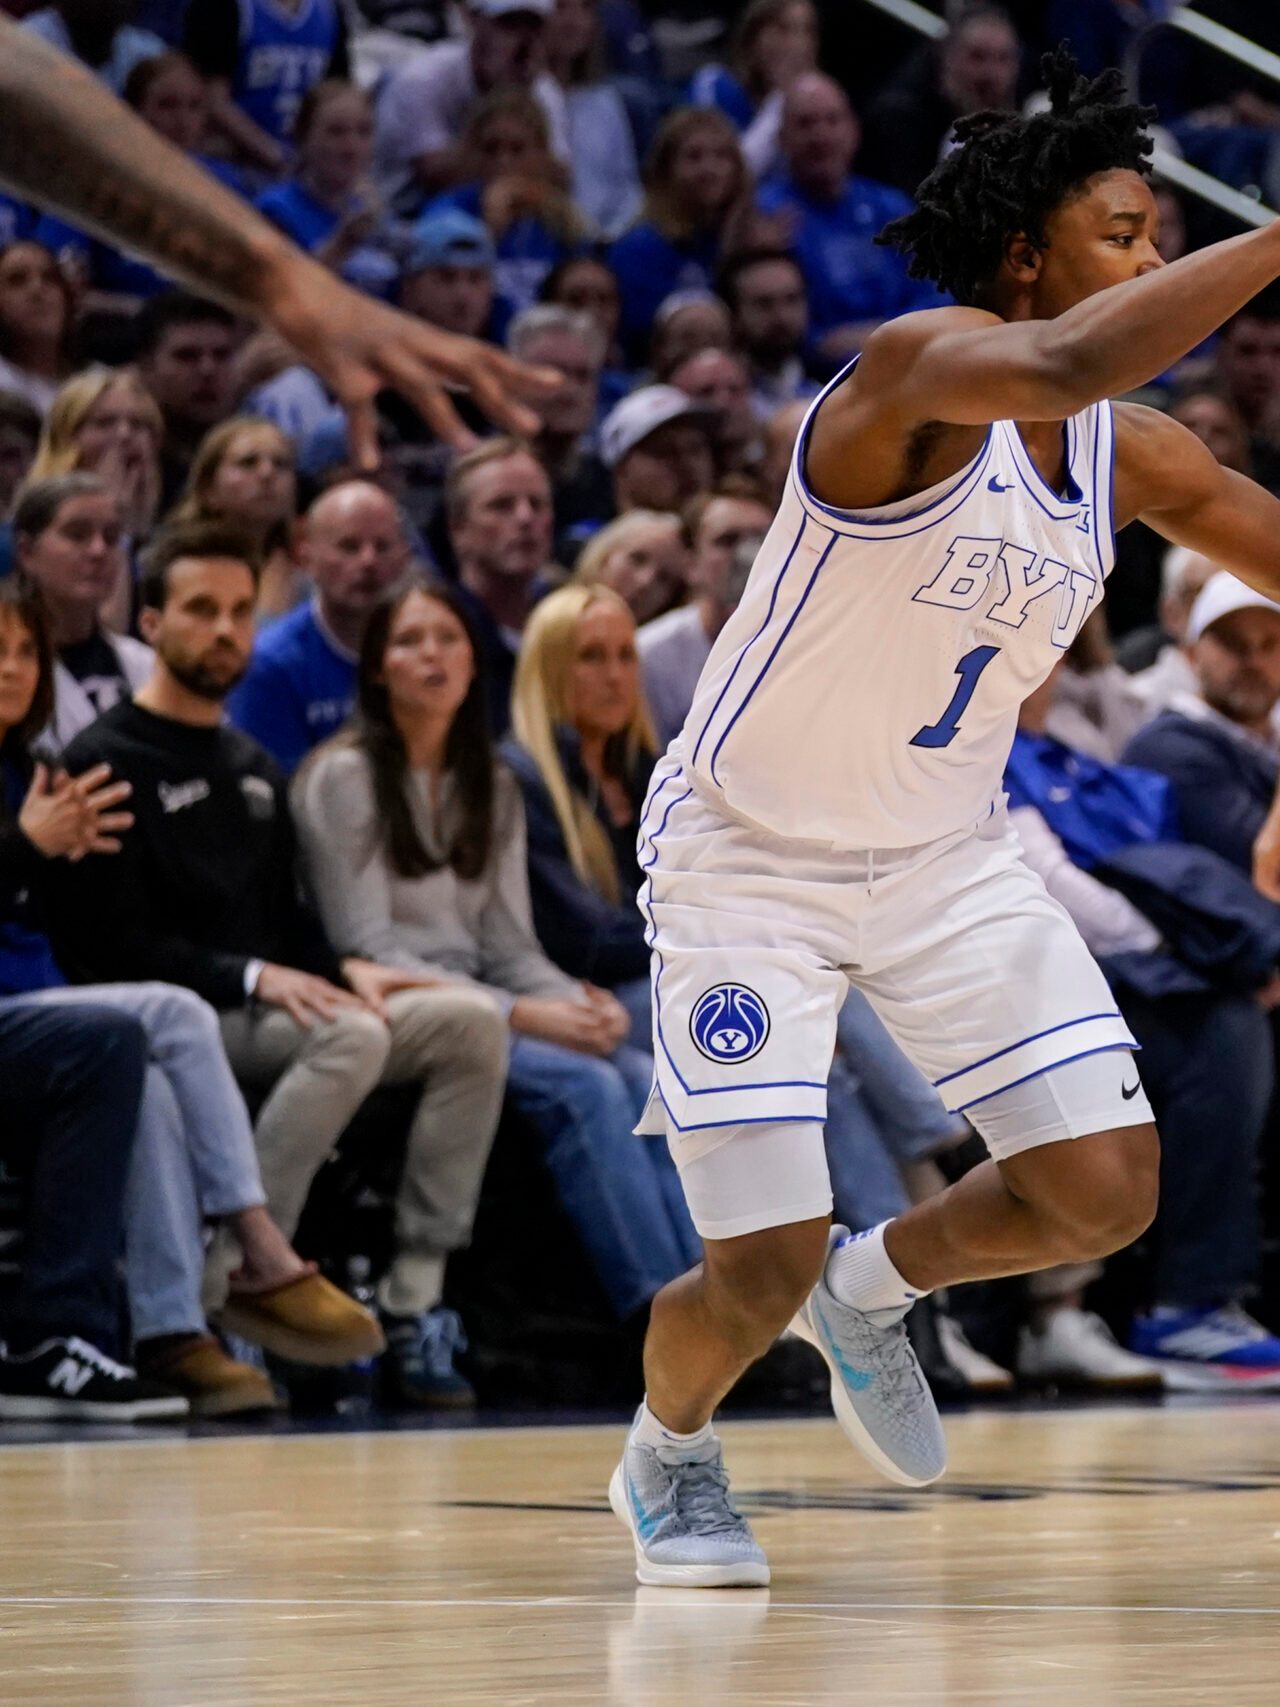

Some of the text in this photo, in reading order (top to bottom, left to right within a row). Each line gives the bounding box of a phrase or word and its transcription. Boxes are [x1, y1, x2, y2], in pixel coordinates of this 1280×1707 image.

[911, 536, 1097, 649] BYU
[908, 645, 1001, 748] 1
[717, 1031, 741, 1050] Y
